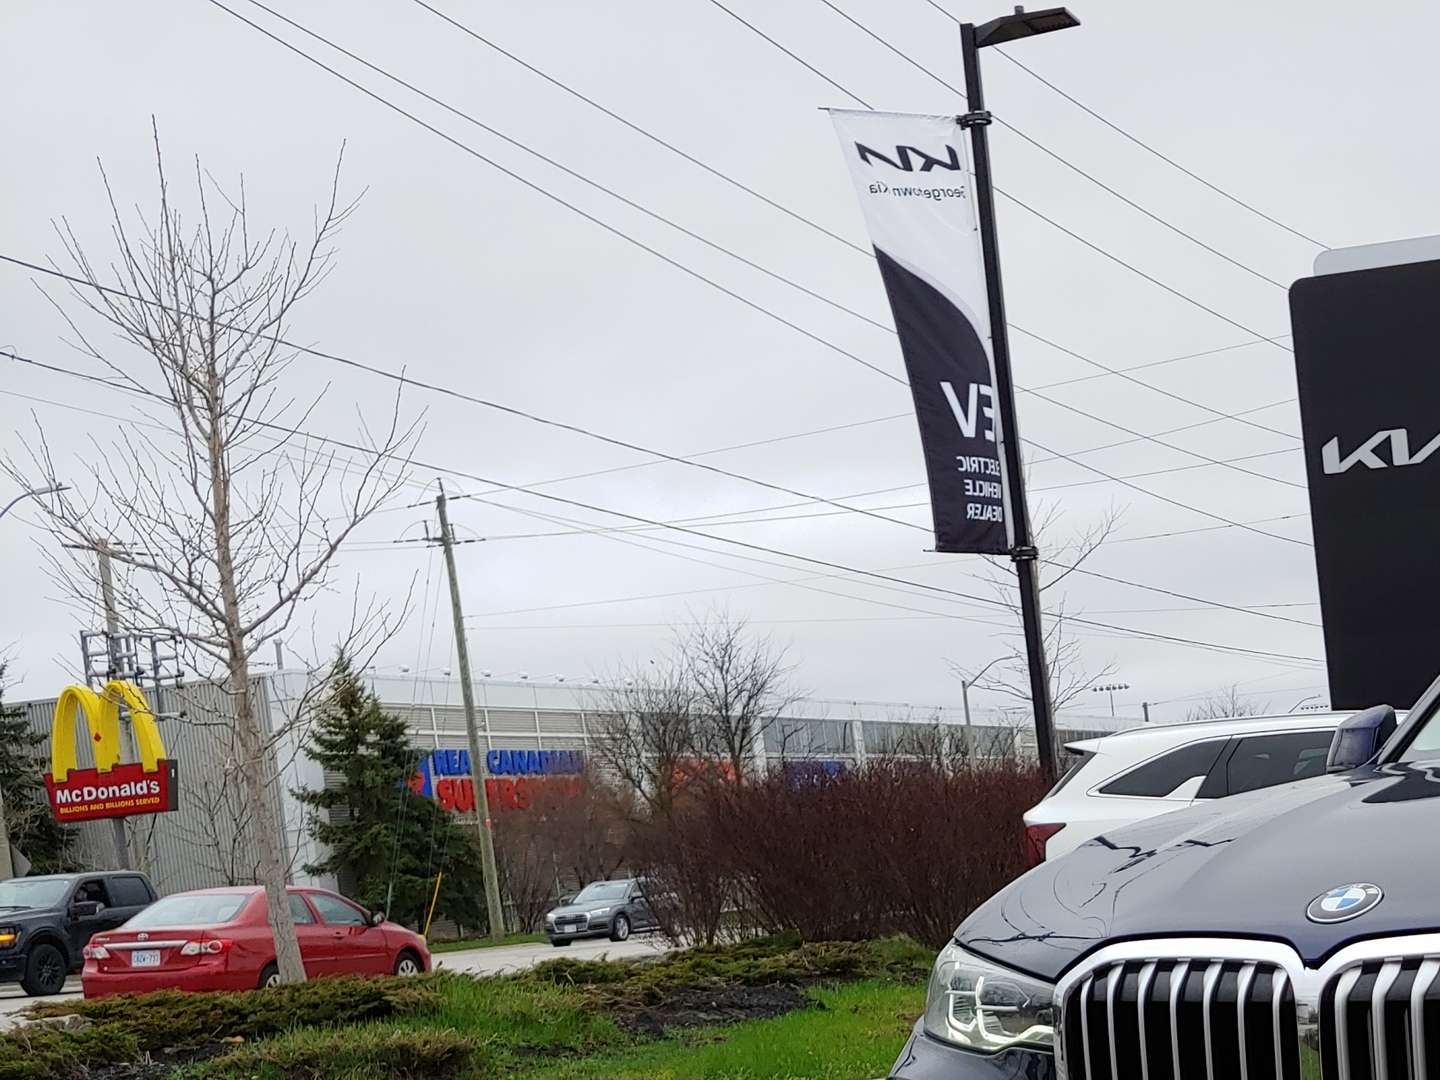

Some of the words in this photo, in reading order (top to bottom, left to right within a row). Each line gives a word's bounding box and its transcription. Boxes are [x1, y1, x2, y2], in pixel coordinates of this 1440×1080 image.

[432, 749, 473, 776] REA
[56, 780, 160, 804] McDonald's
[60, 805, 88, 815] BILLIONS
[90, 803, 104, 811] AND
[105, 800, 135, 810] BILLIONS
[136, 797, 160, 806] SERVED
